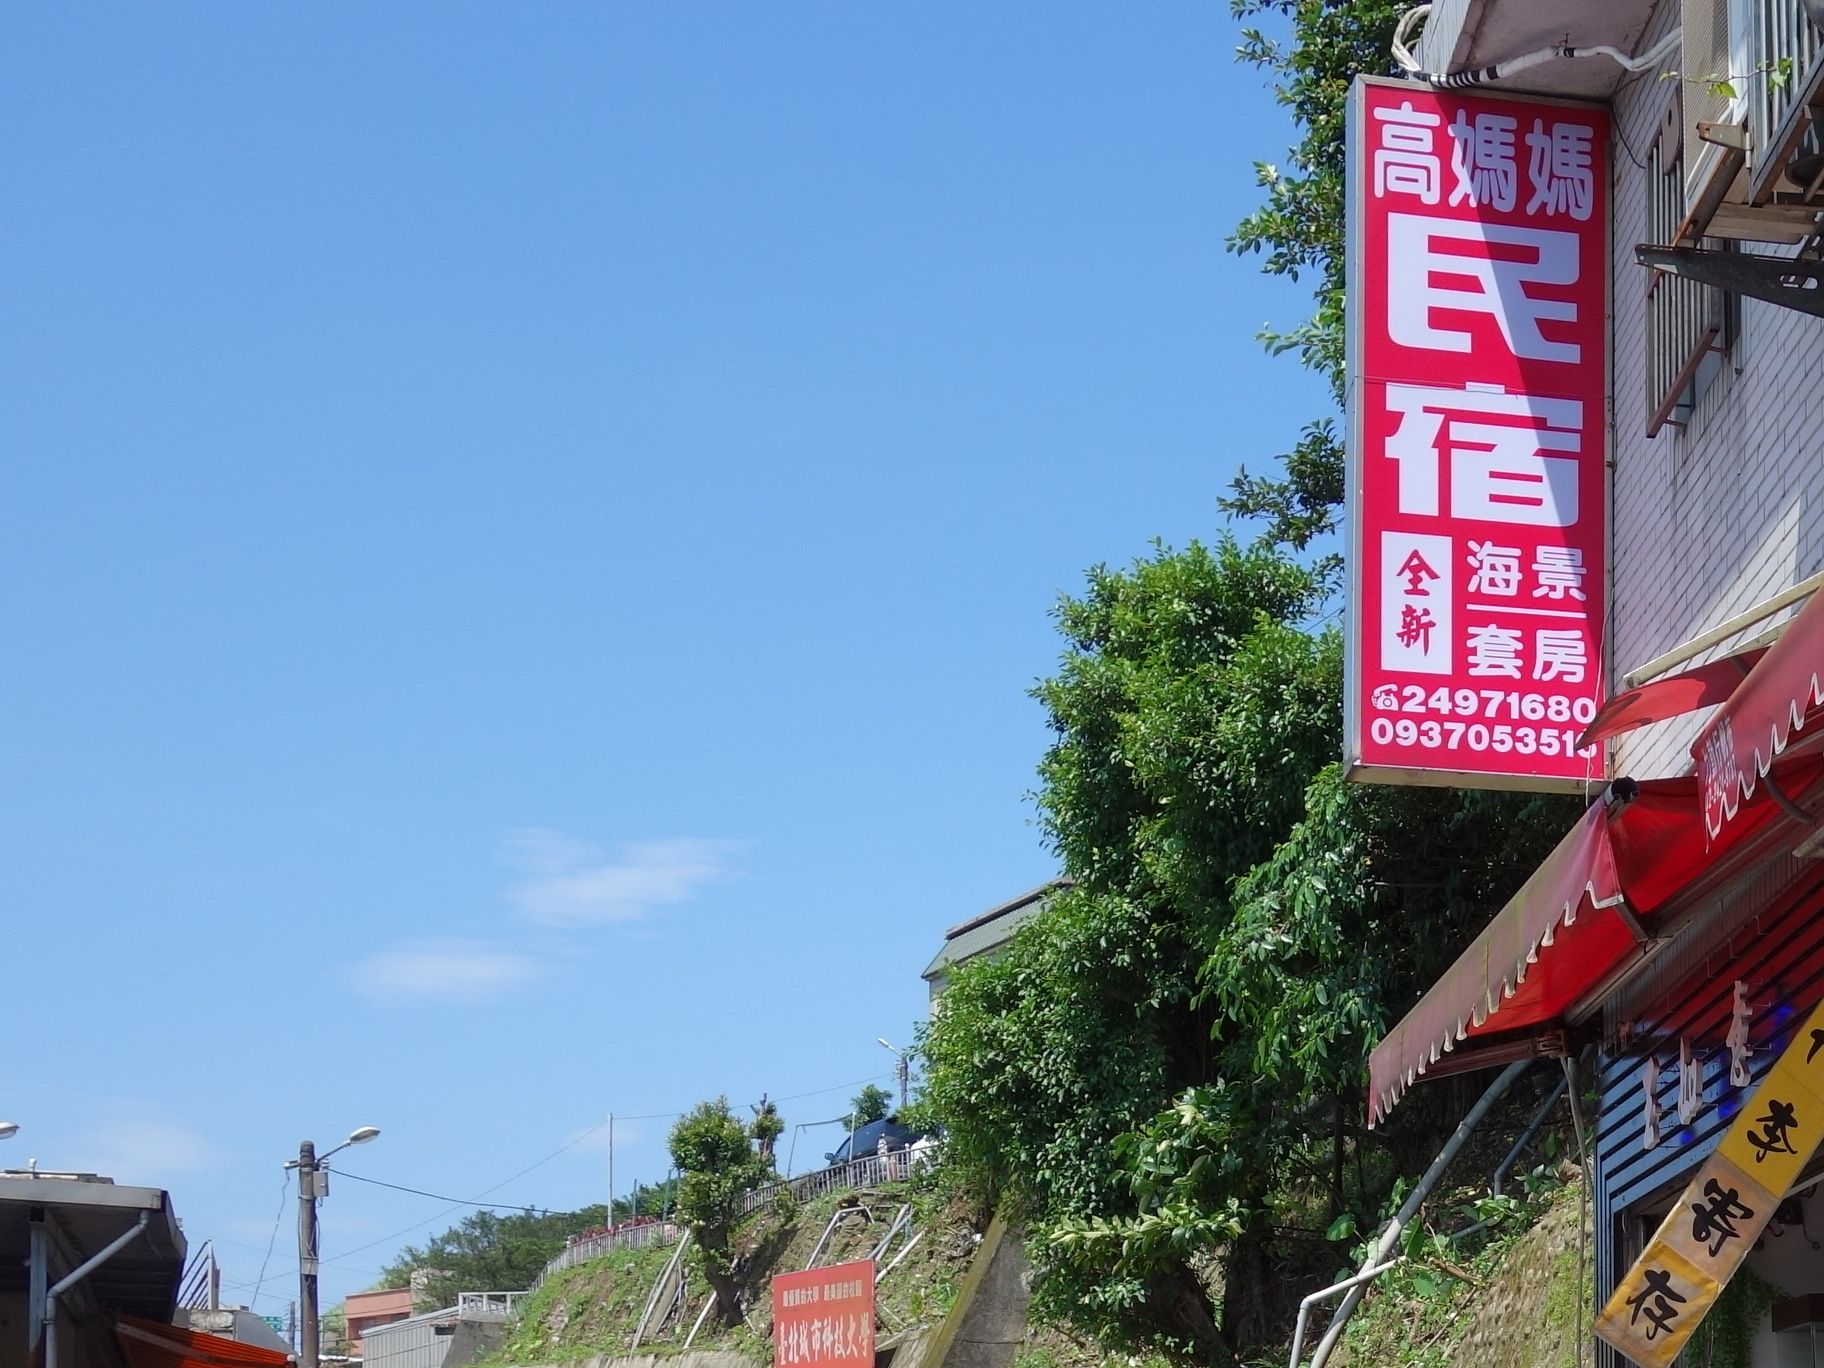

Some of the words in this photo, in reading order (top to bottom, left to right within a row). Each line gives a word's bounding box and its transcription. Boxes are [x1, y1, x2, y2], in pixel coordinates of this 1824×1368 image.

[1371, 100, 1594, 222] 高媽媽
[1383, 210, 1584, 529] 民宿
[1396, 549, 1441, 657] 全新
[1466, 540, 1588, 602] 海景
[1466, 623, 1588, 684] 套房
[1401, 684, 1597, 724] 24971680
